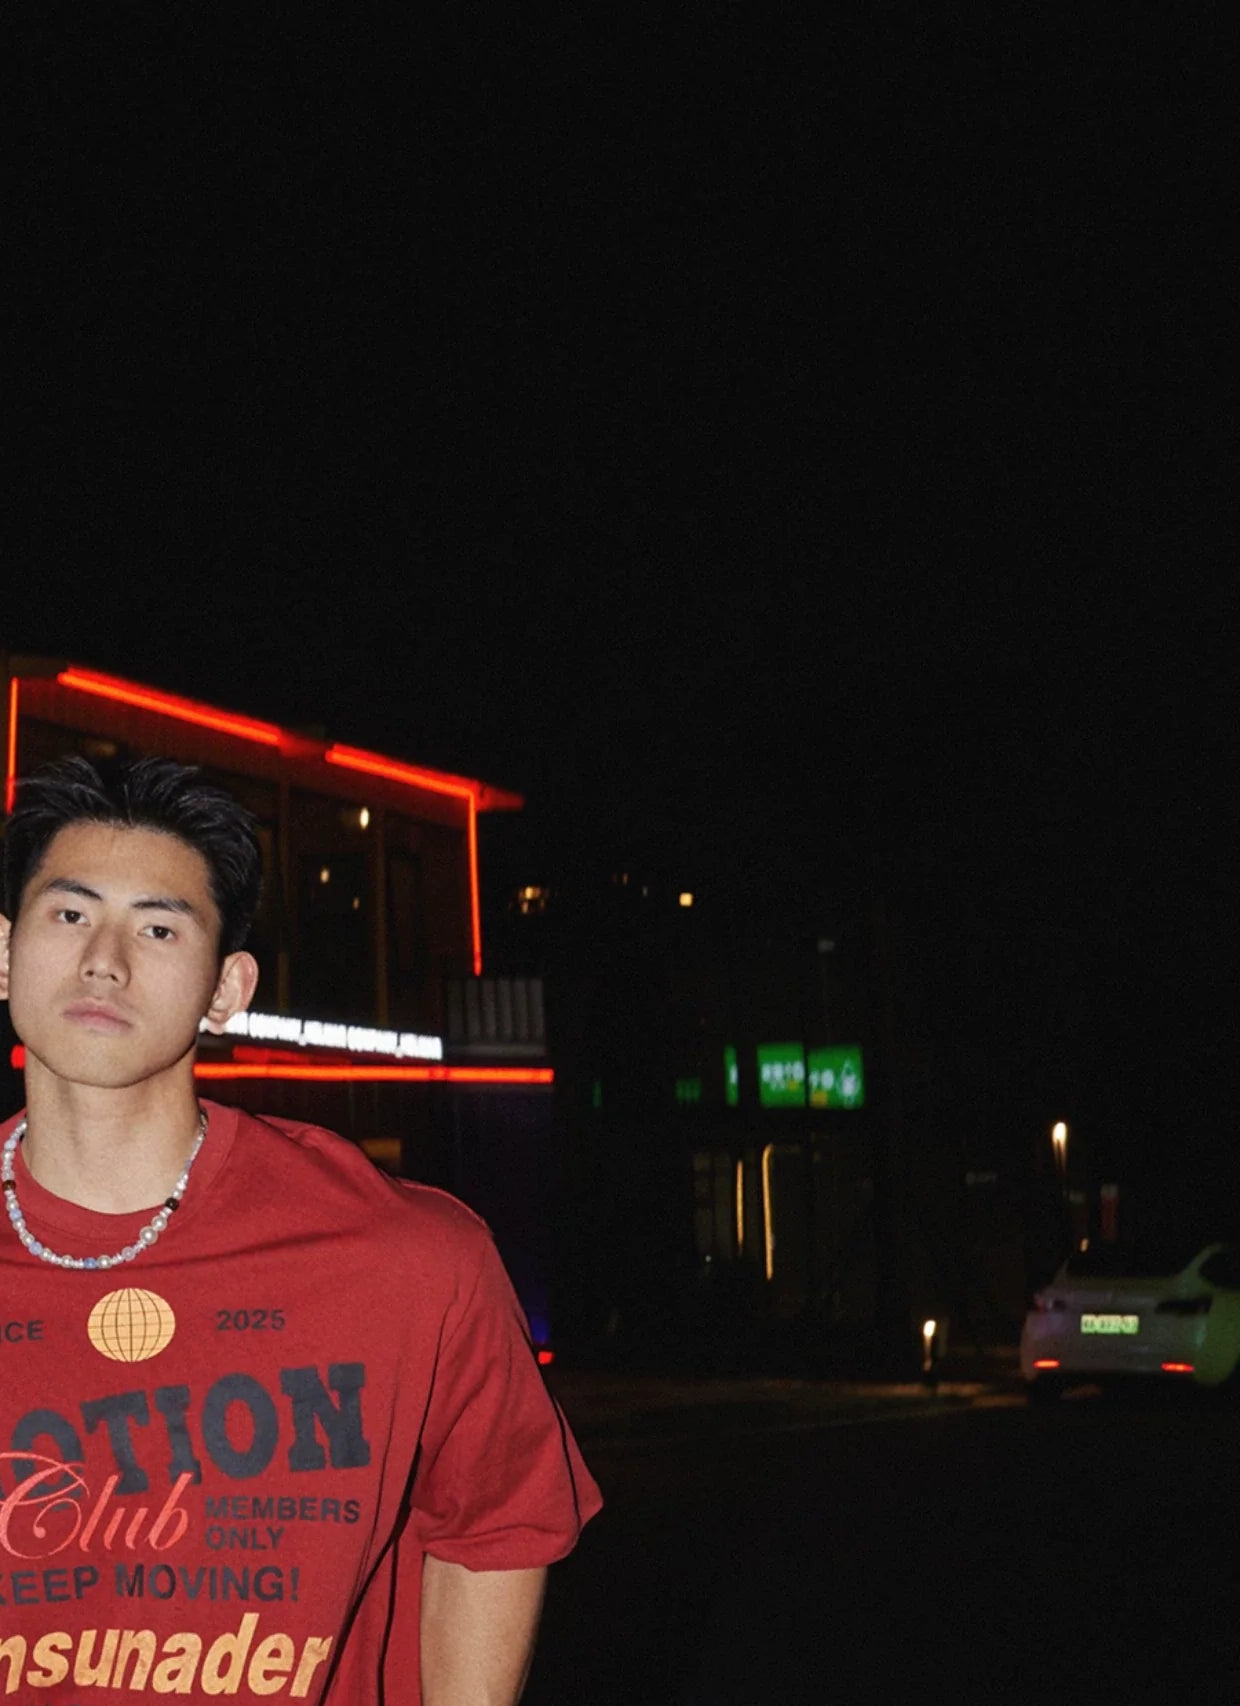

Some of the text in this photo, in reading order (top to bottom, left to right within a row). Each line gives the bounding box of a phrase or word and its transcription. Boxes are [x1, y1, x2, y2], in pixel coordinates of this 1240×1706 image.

[216, 1308, 286, 1332] 2025
[205, 1496, 360, 1524] MEMBERS
[205, 1525, 285, 1551] ONLY
[114, 1562, 300, 1602] MOVING!
